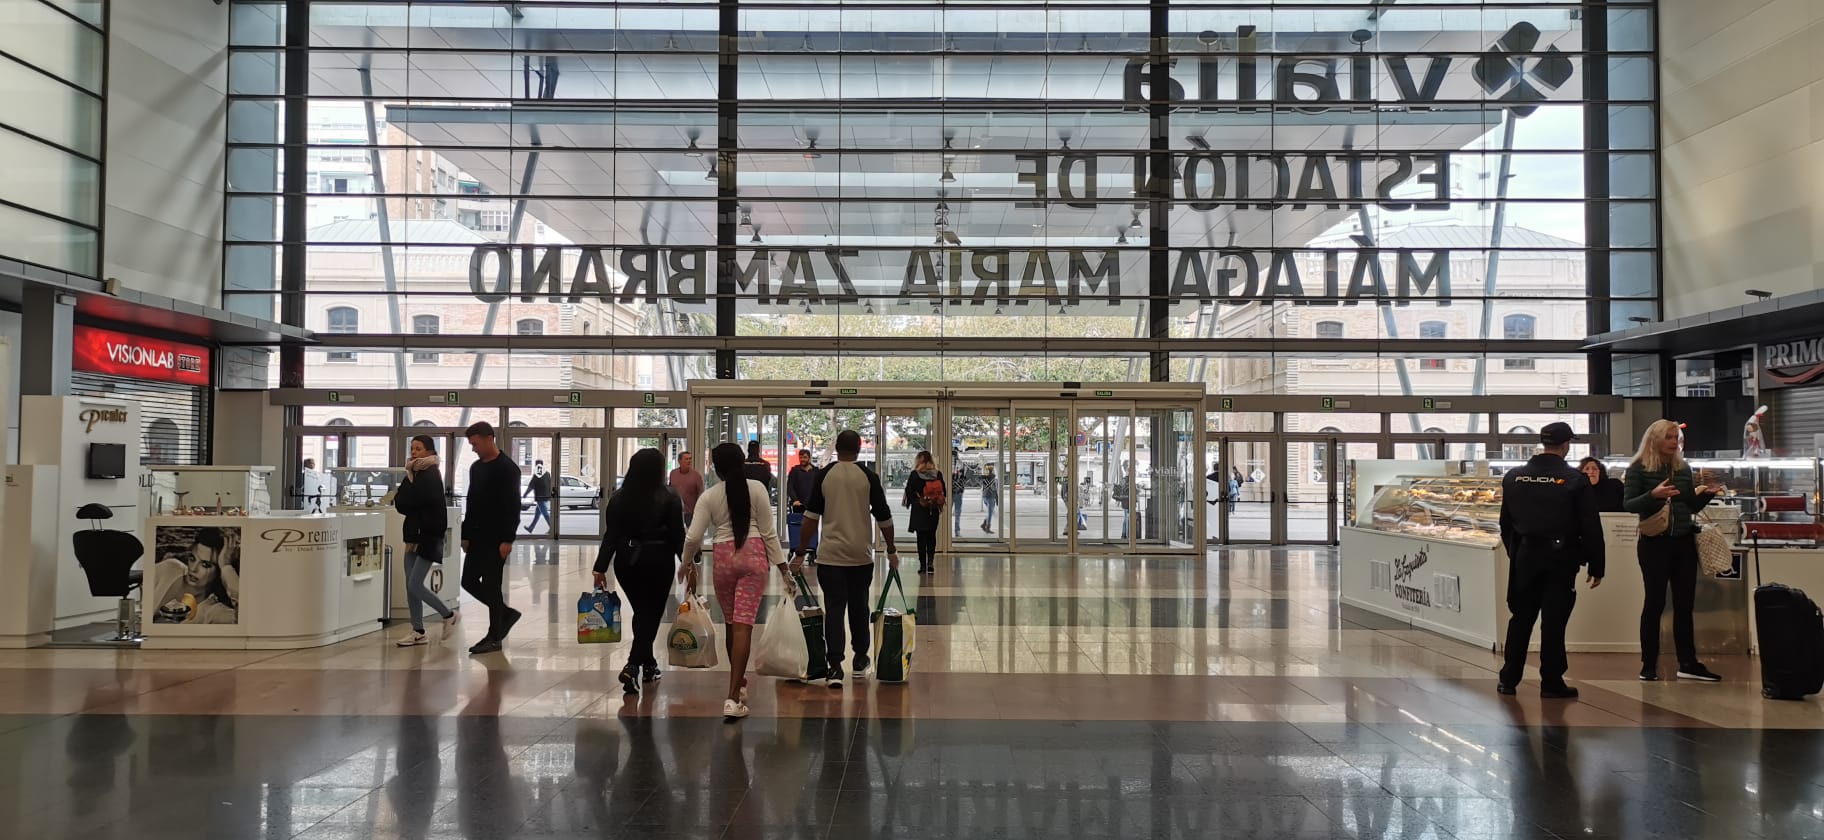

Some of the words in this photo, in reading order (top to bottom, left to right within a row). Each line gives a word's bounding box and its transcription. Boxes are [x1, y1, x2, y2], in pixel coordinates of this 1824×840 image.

[106, 342, 174, 369] VISIONLAB
[79, 408, 128, 434] Premier
[260, 528, 339, 553] Premier
[1394, 584, 1431, 607] CONFITERÍA
